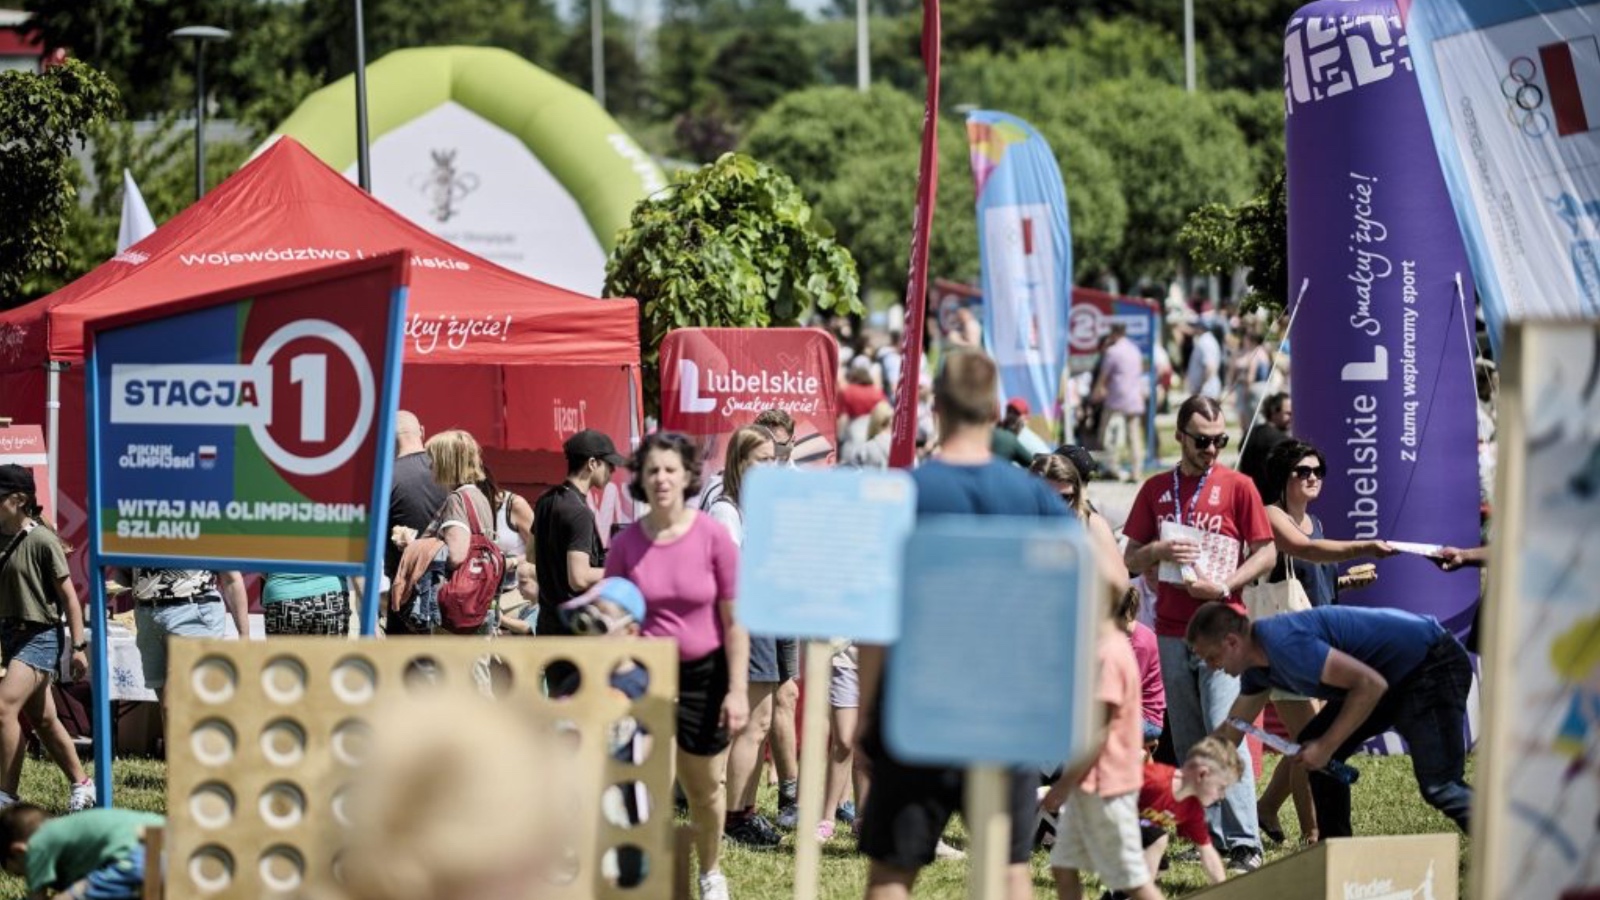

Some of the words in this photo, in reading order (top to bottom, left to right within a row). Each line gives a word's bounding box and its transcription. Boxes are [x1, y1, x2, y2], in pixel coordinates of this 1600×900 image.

[1349, 171, 1388, 243] życie!
[180, 247, 351, 266] Województwo
[1348, 245, 1392, 336] Smakuj
[1401, 260, 1418, 304] sport
[447, 314, 513, 350] życie!
[1400, 307, 1419, 398] wspieramy
[124, 379, 260, 407] STACJA
[707, 368, 818, 394] lubelskie
[290, 353, 328, 443] 1
[721, 396, 777, 417] Smakuj
[1401, 401, 1419, 447] dumą
[127, 443, 174, 456] PIKNIK
[1401, 450, 1416, 462] Z
[1346, 394, 1378, 540] ubelskie
[117, 498, 186, 518] WITAJ
[189, 499, 221, 520] NA
[225, 500, 366, 523] OLIMPIJSKIM
[116, 519, 201, 539] SZLAKU
